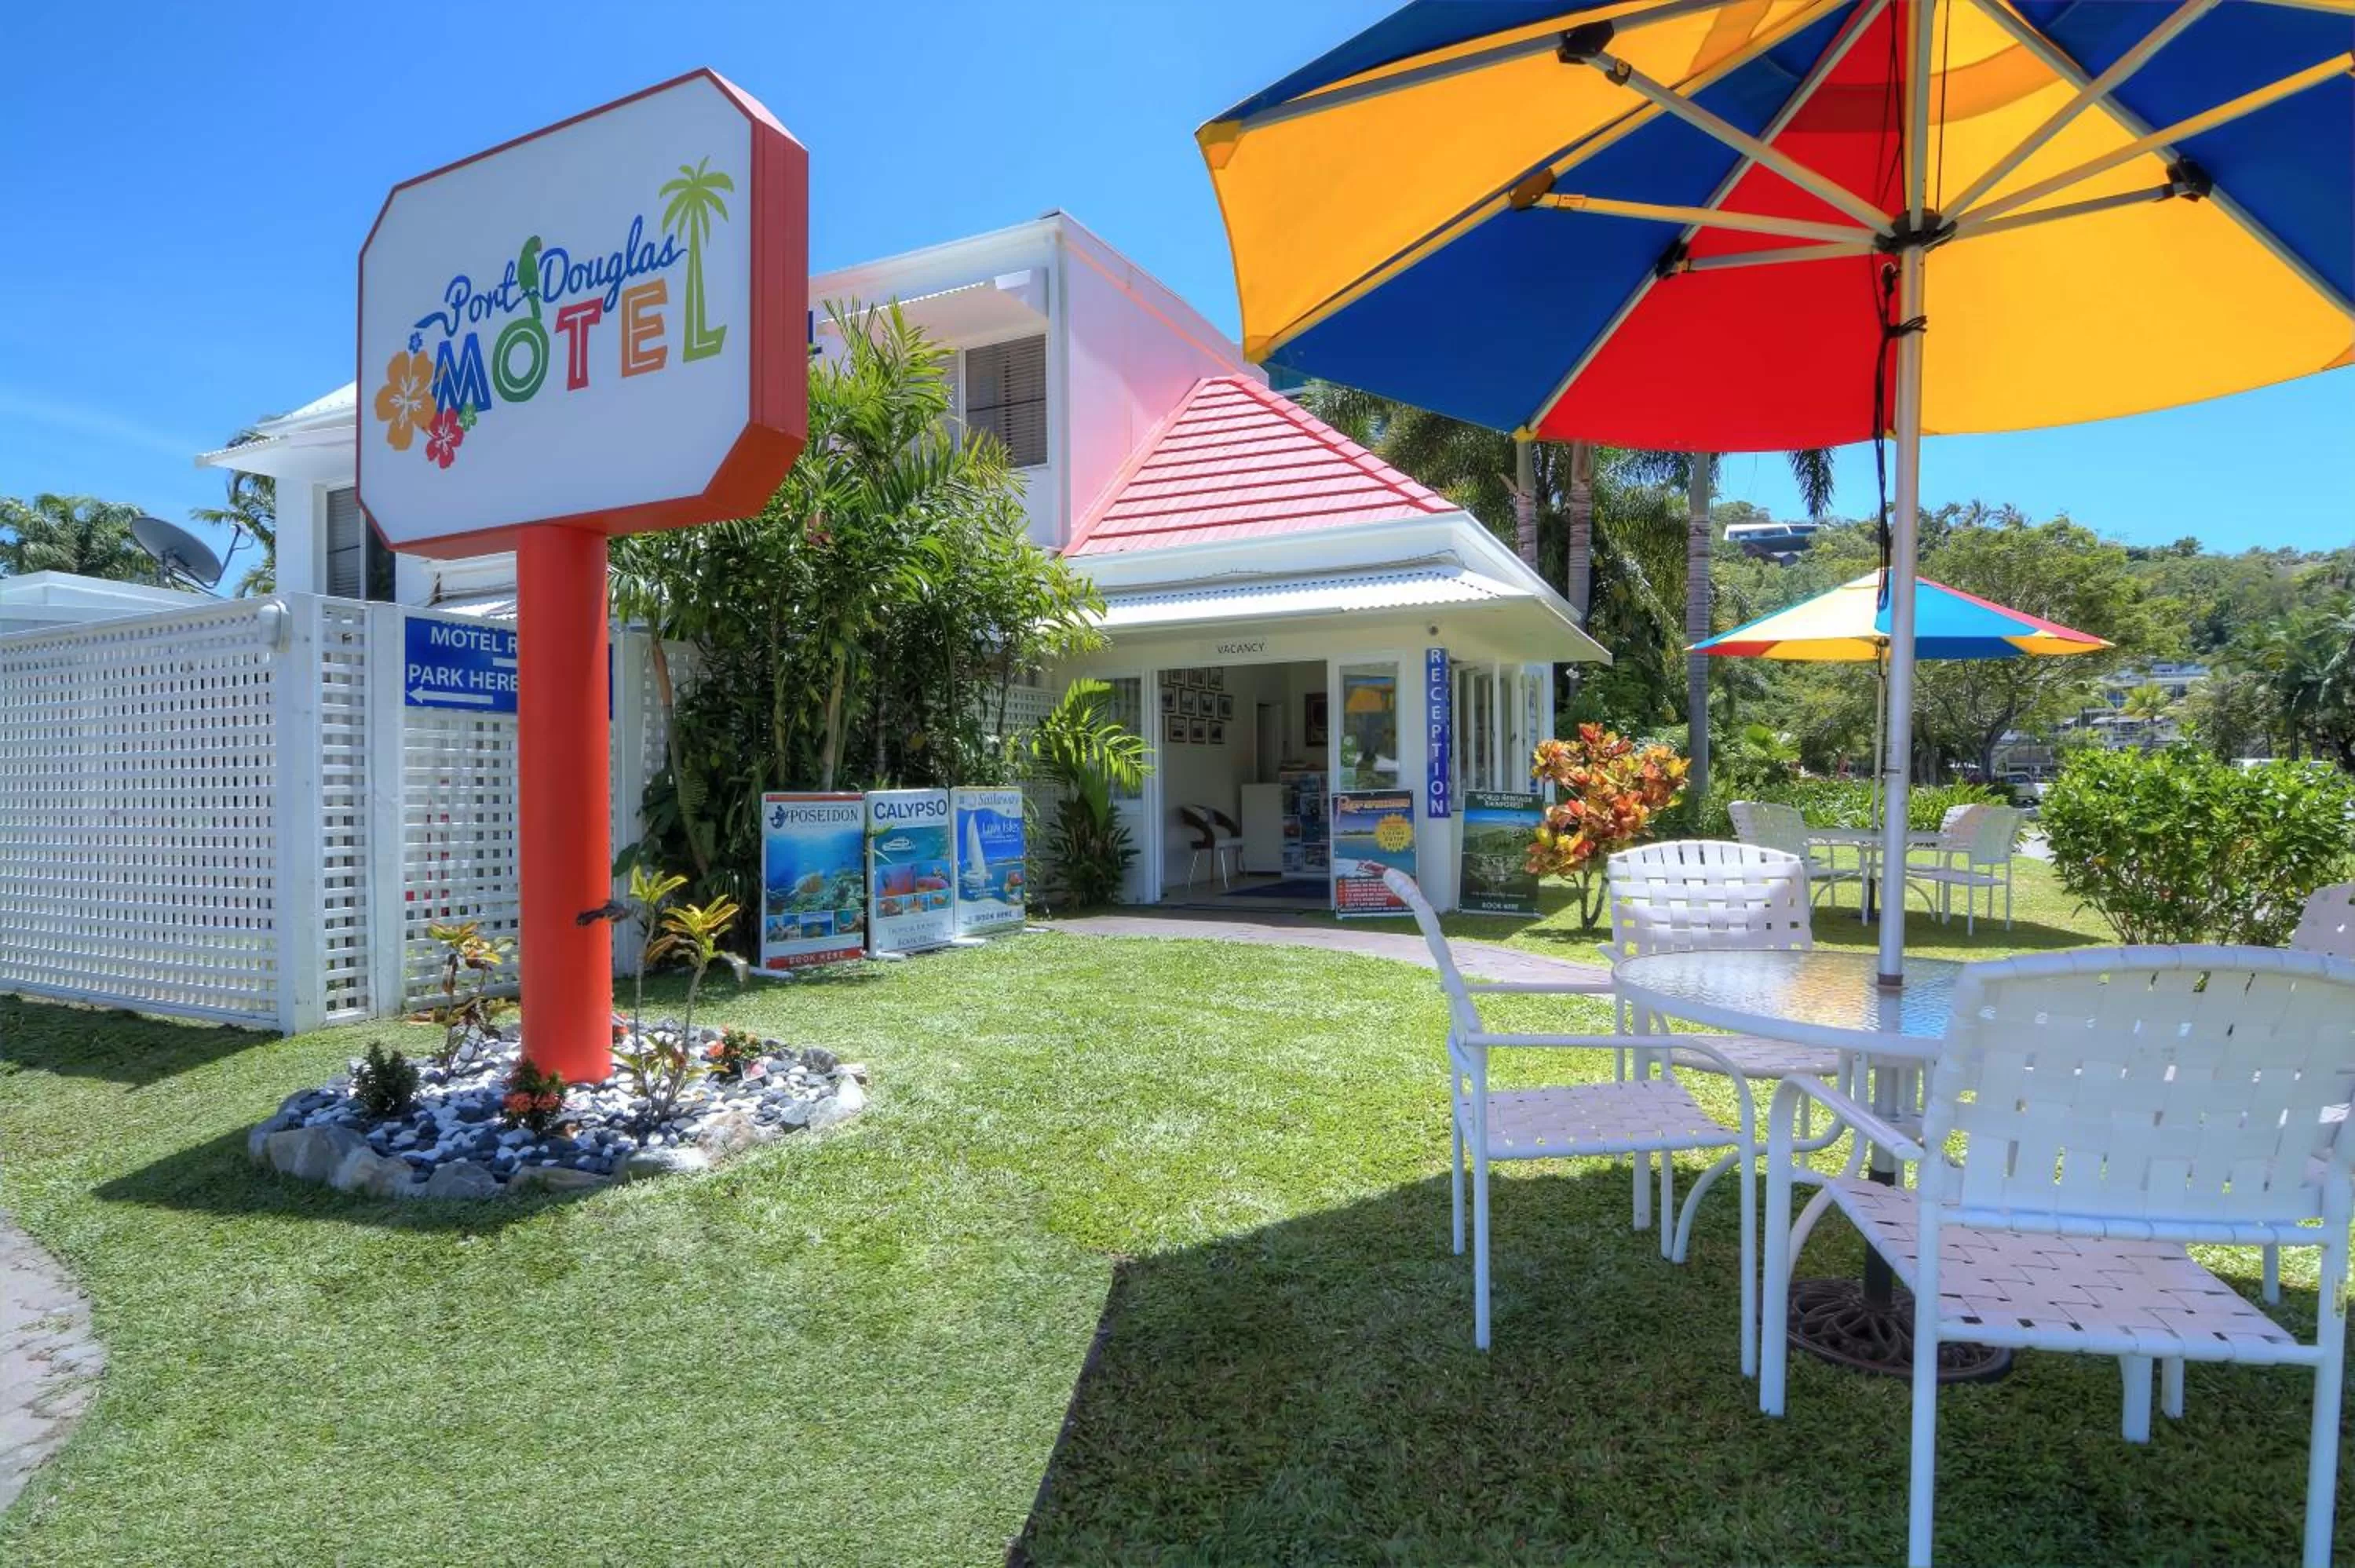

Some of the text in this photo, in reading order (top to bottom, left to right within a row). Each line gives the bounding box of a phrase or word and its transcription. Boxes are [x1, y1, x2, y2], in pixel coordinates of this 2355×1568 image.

[414, 213, 688, 337] Port Douglas
[430, 188, 728, 414] MOTEL
[430, 625, 502, 652] MOTEL
[1218, 642, 1265, 654] VACANCY
[408, 663, 518, 691] PARK HERE
[1430, 649, 1444, 814] RECEPTION
[787, 808, 858, 823] POSEIDON
[874, 799, 947, 819] CALYPSO
[789, 954, 816, 965] BOOK
